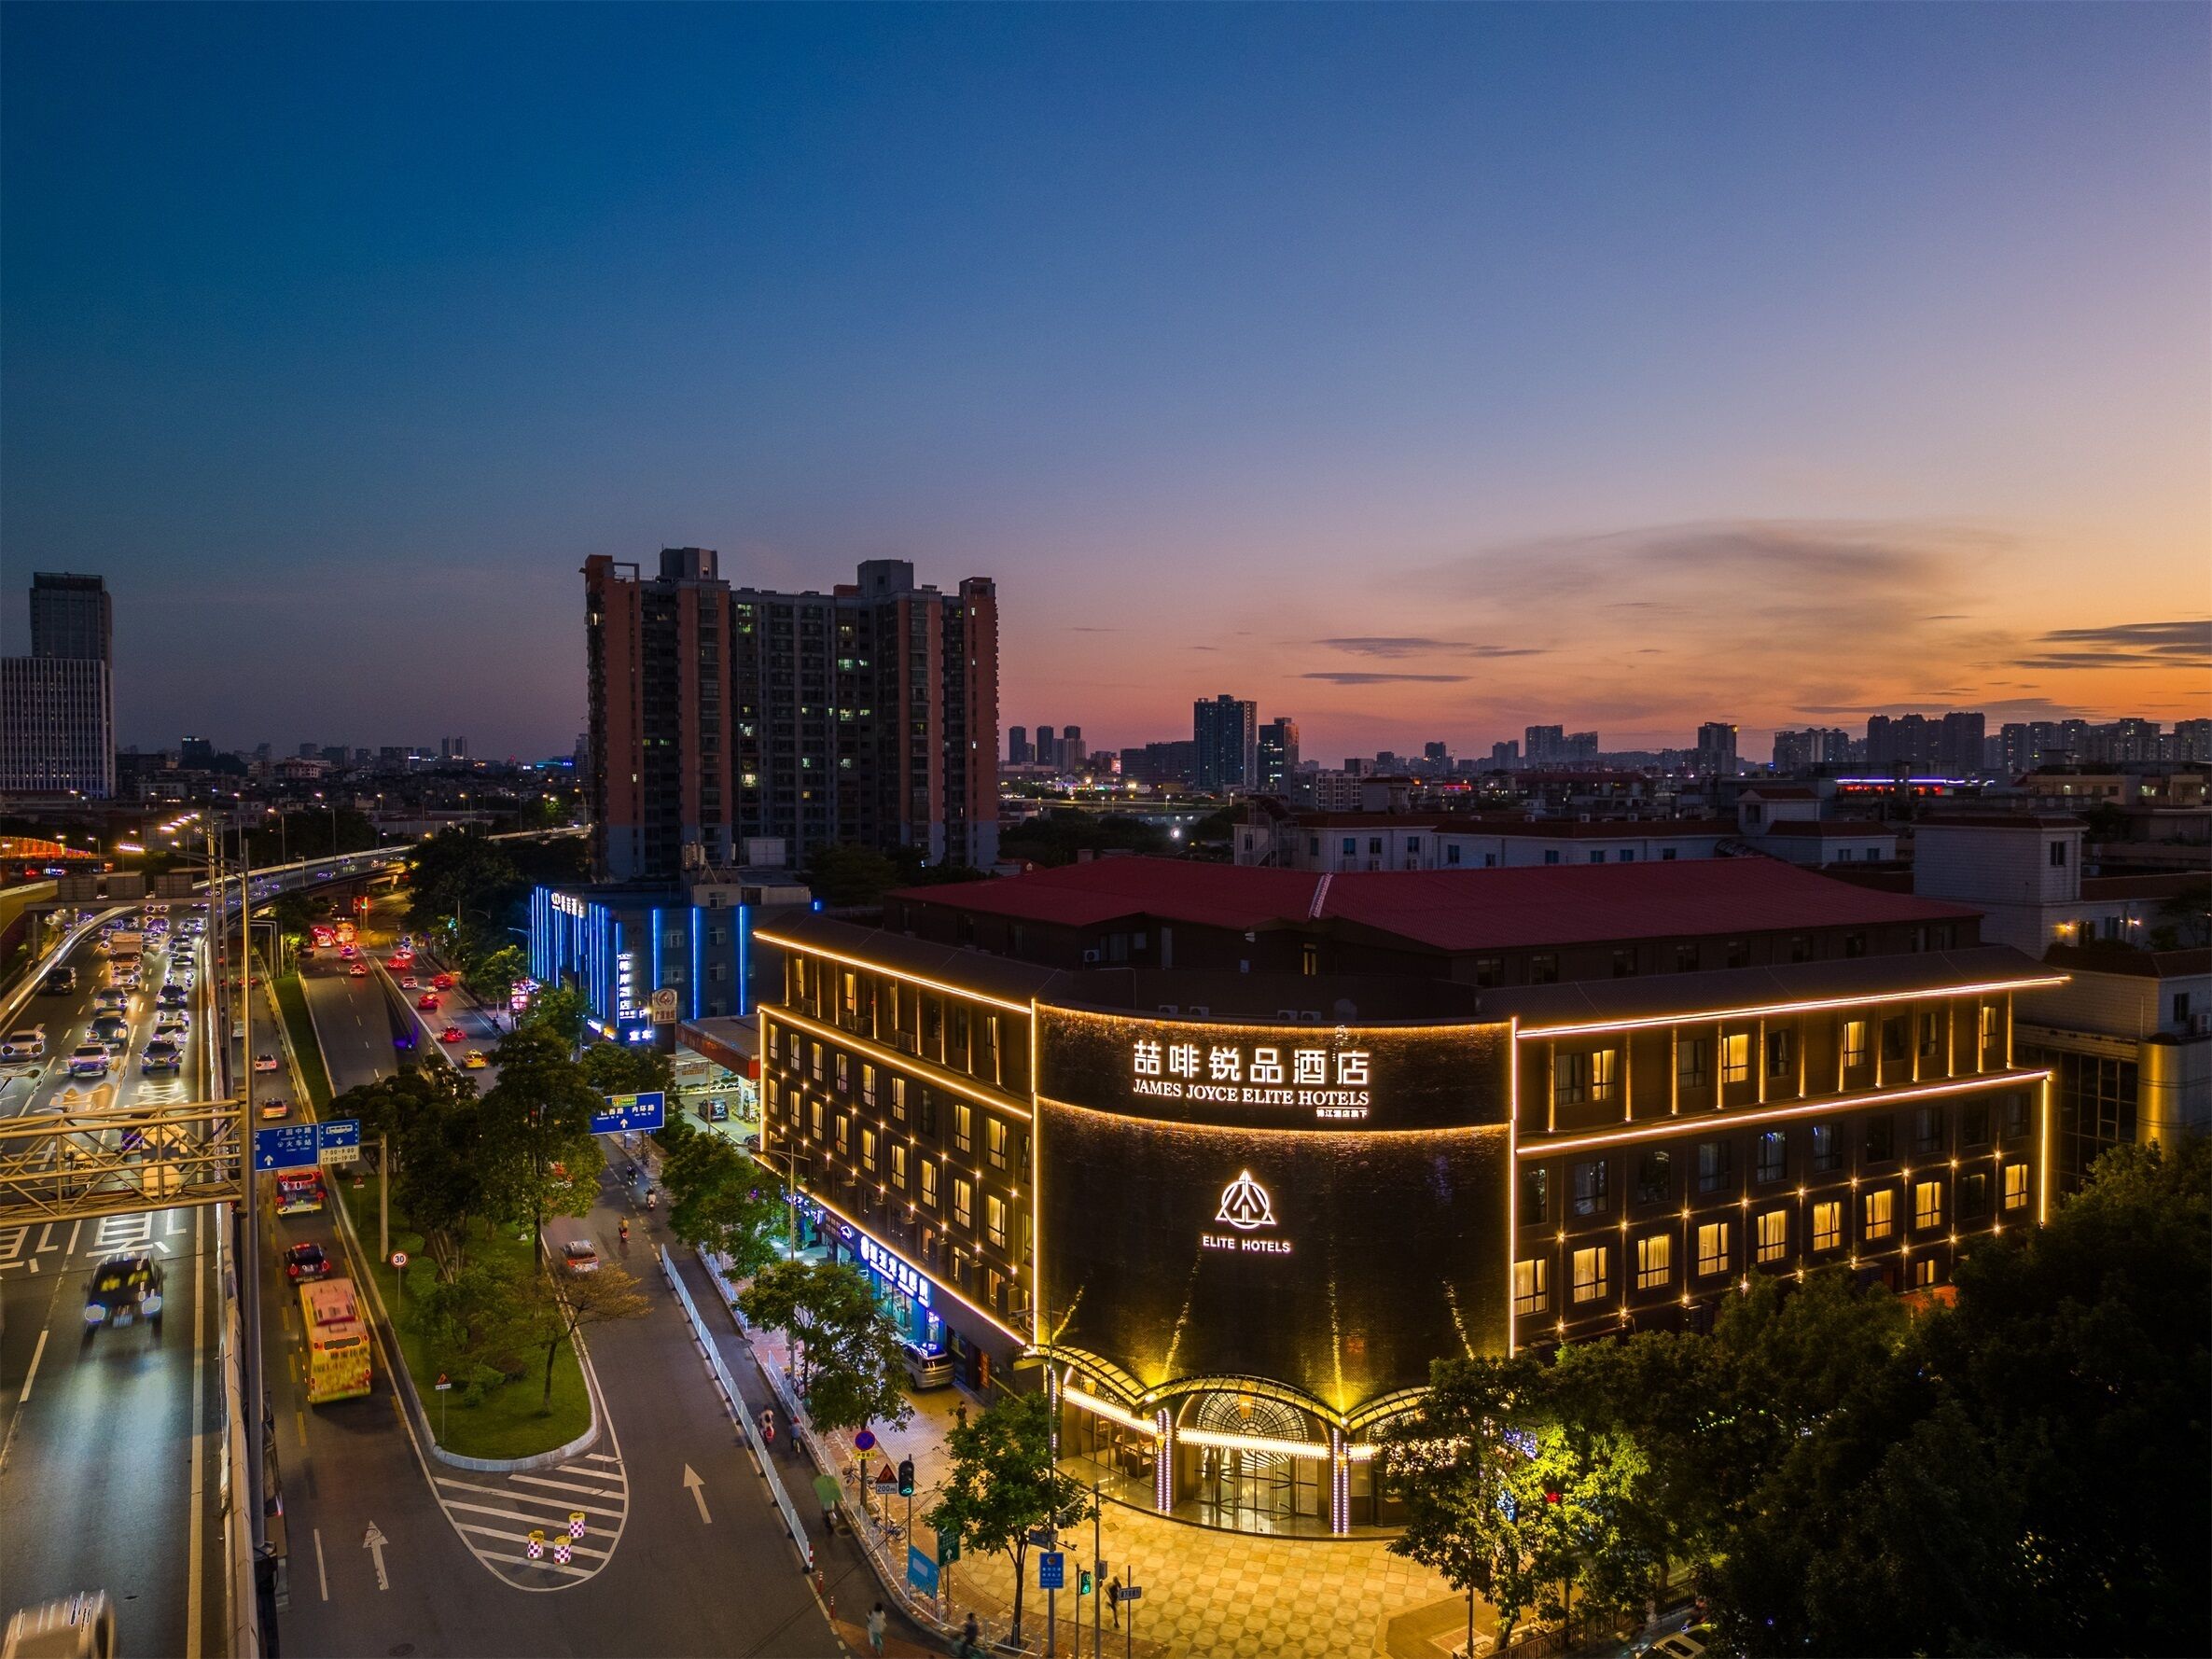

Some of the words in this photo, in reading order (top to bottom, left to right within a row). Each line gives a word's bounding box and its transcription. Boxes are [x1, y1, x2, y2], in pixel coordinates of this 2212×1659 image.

[1133, 1039, 1370, 1085] 喆啡锐品酒店
[1133, 1079, 1182, 1097] JAMES
[1186, 1084, 1238, 1103] JOYCE
[1243, 1088, 1294, 1106] ELITE
[1298, 1091, 1370, 1106] HOTELS
[1203, 1235, 1236, 1250] ELITE
[1242, 1239, 1291, 1253] HOTELS
[395, 1255, 405, 1263] 30
